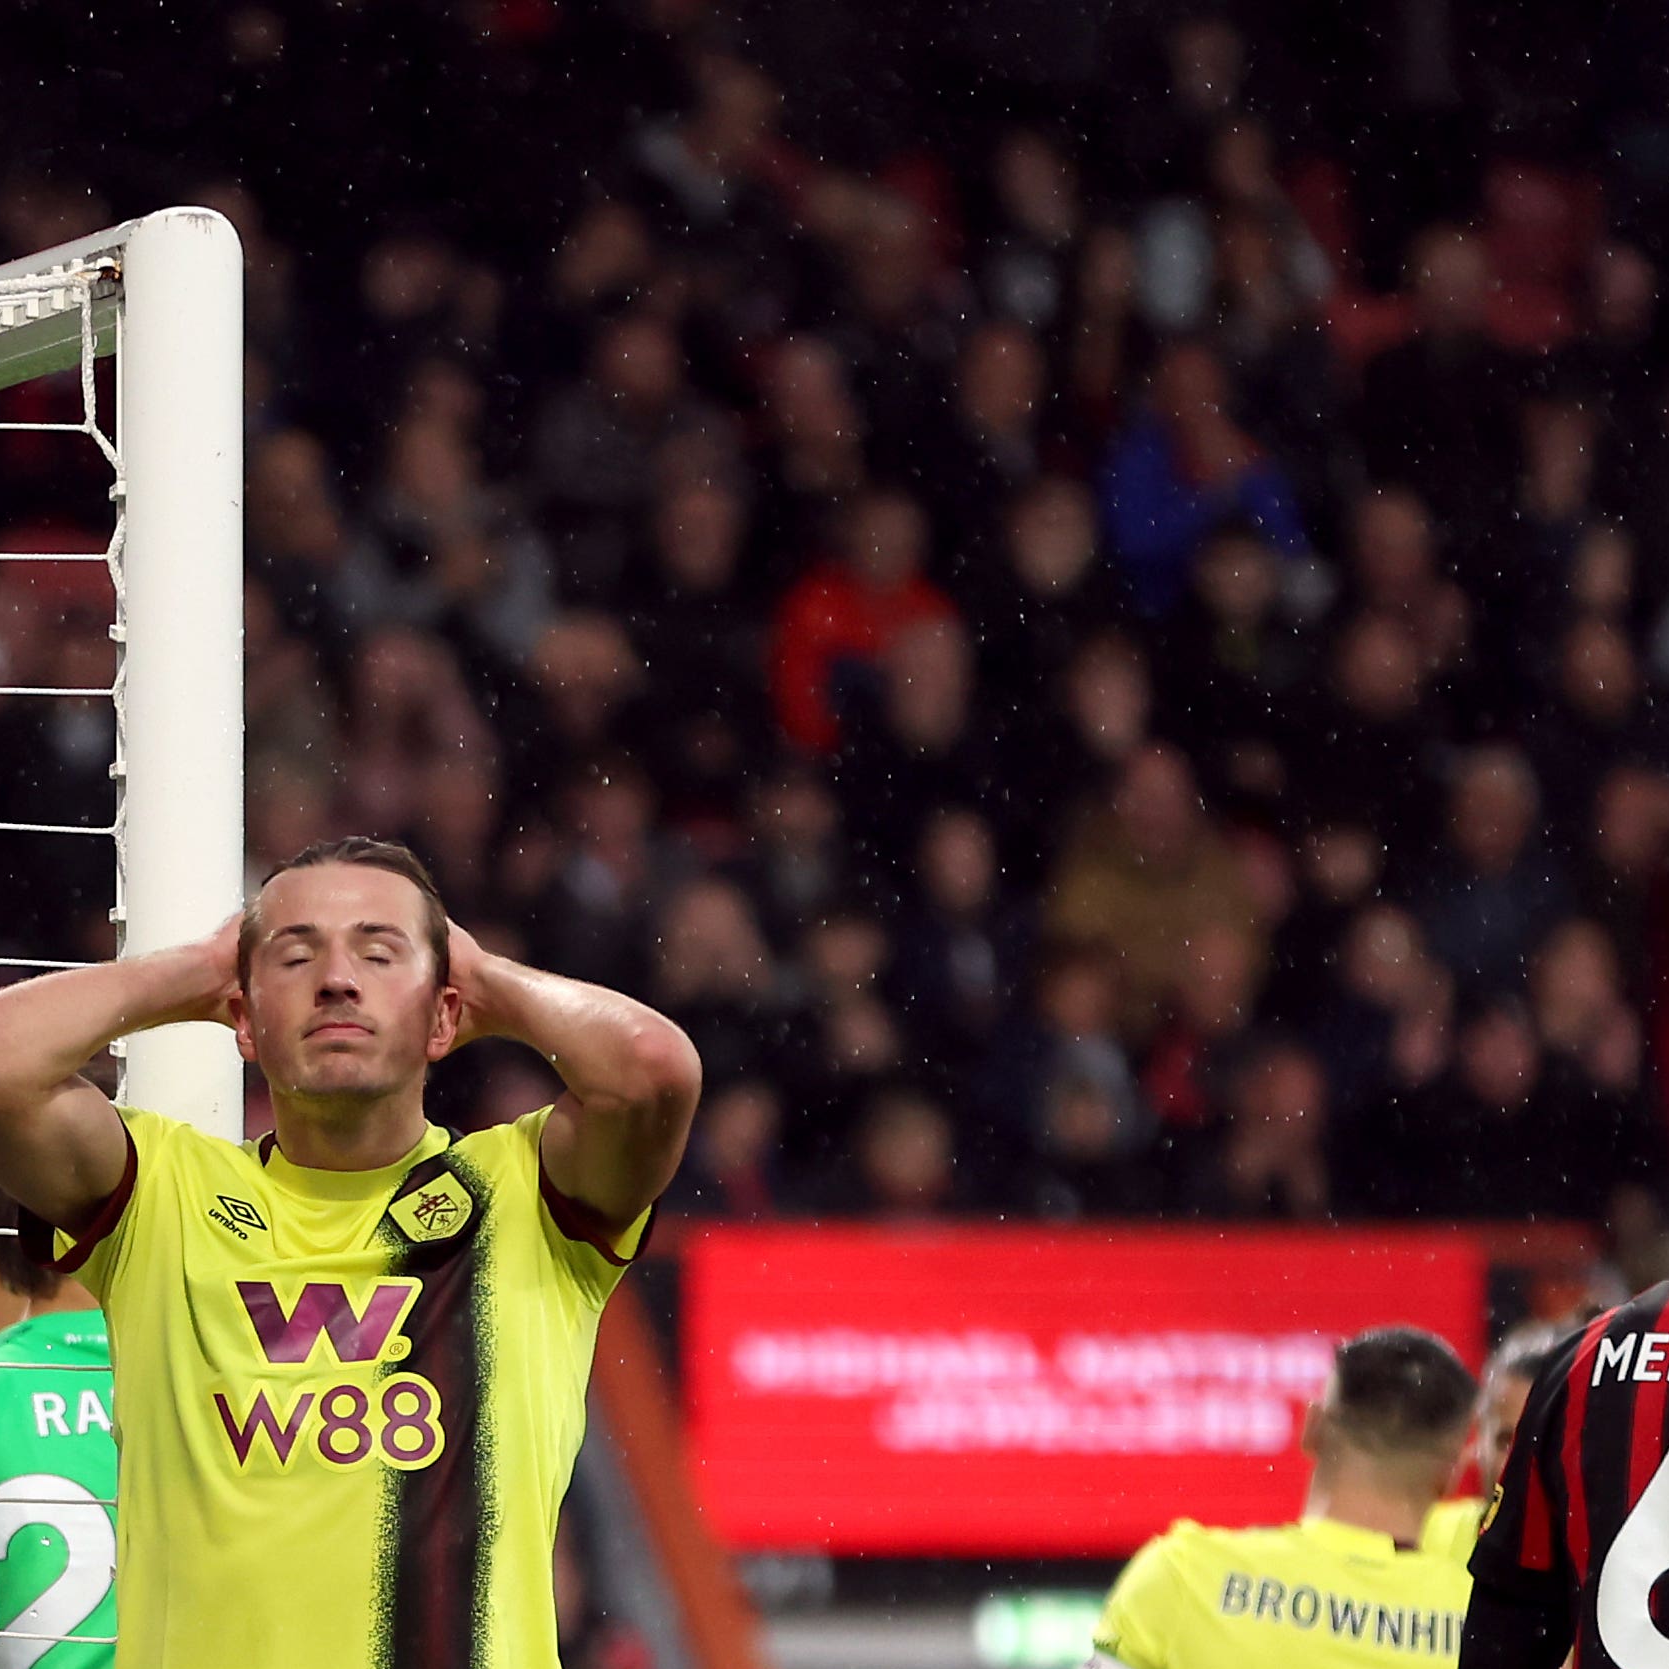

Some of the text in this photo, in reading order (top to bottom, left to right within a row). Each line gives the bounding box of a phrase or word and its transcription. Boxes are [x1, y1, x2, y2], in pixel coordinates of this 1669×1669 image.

[208, 1208, 249, 1240] umbro
[32, 1389, 115, 1438] RA
[213, 1381, 436, 1468] W88
[1221, 1572, 1464, 1657] BROWNHI
